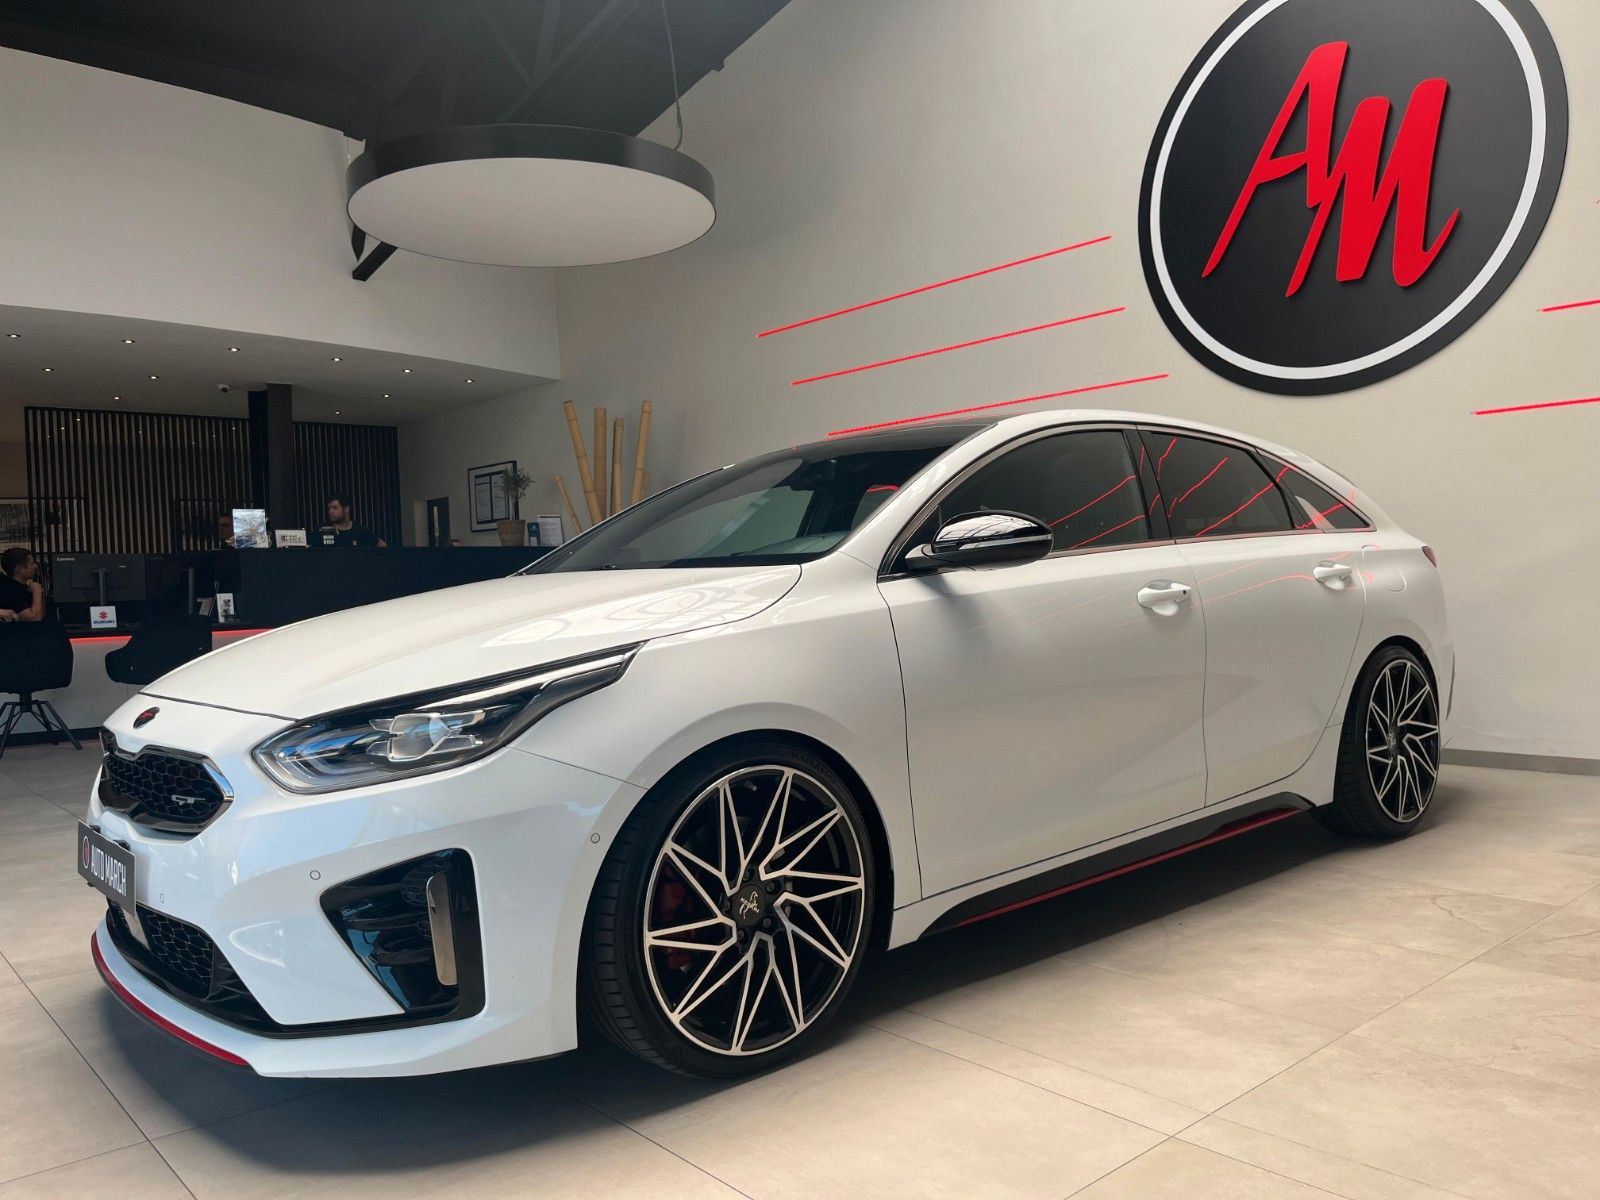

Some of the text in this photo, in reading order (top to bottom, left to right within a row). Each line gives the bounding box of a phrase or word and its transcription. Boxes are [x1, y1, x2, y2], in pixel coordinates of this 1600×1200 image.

[1202, 41, 1461, 297] AM
[171, 795, 206, 806] GT
[90, 845, 105, 881] AUTO
